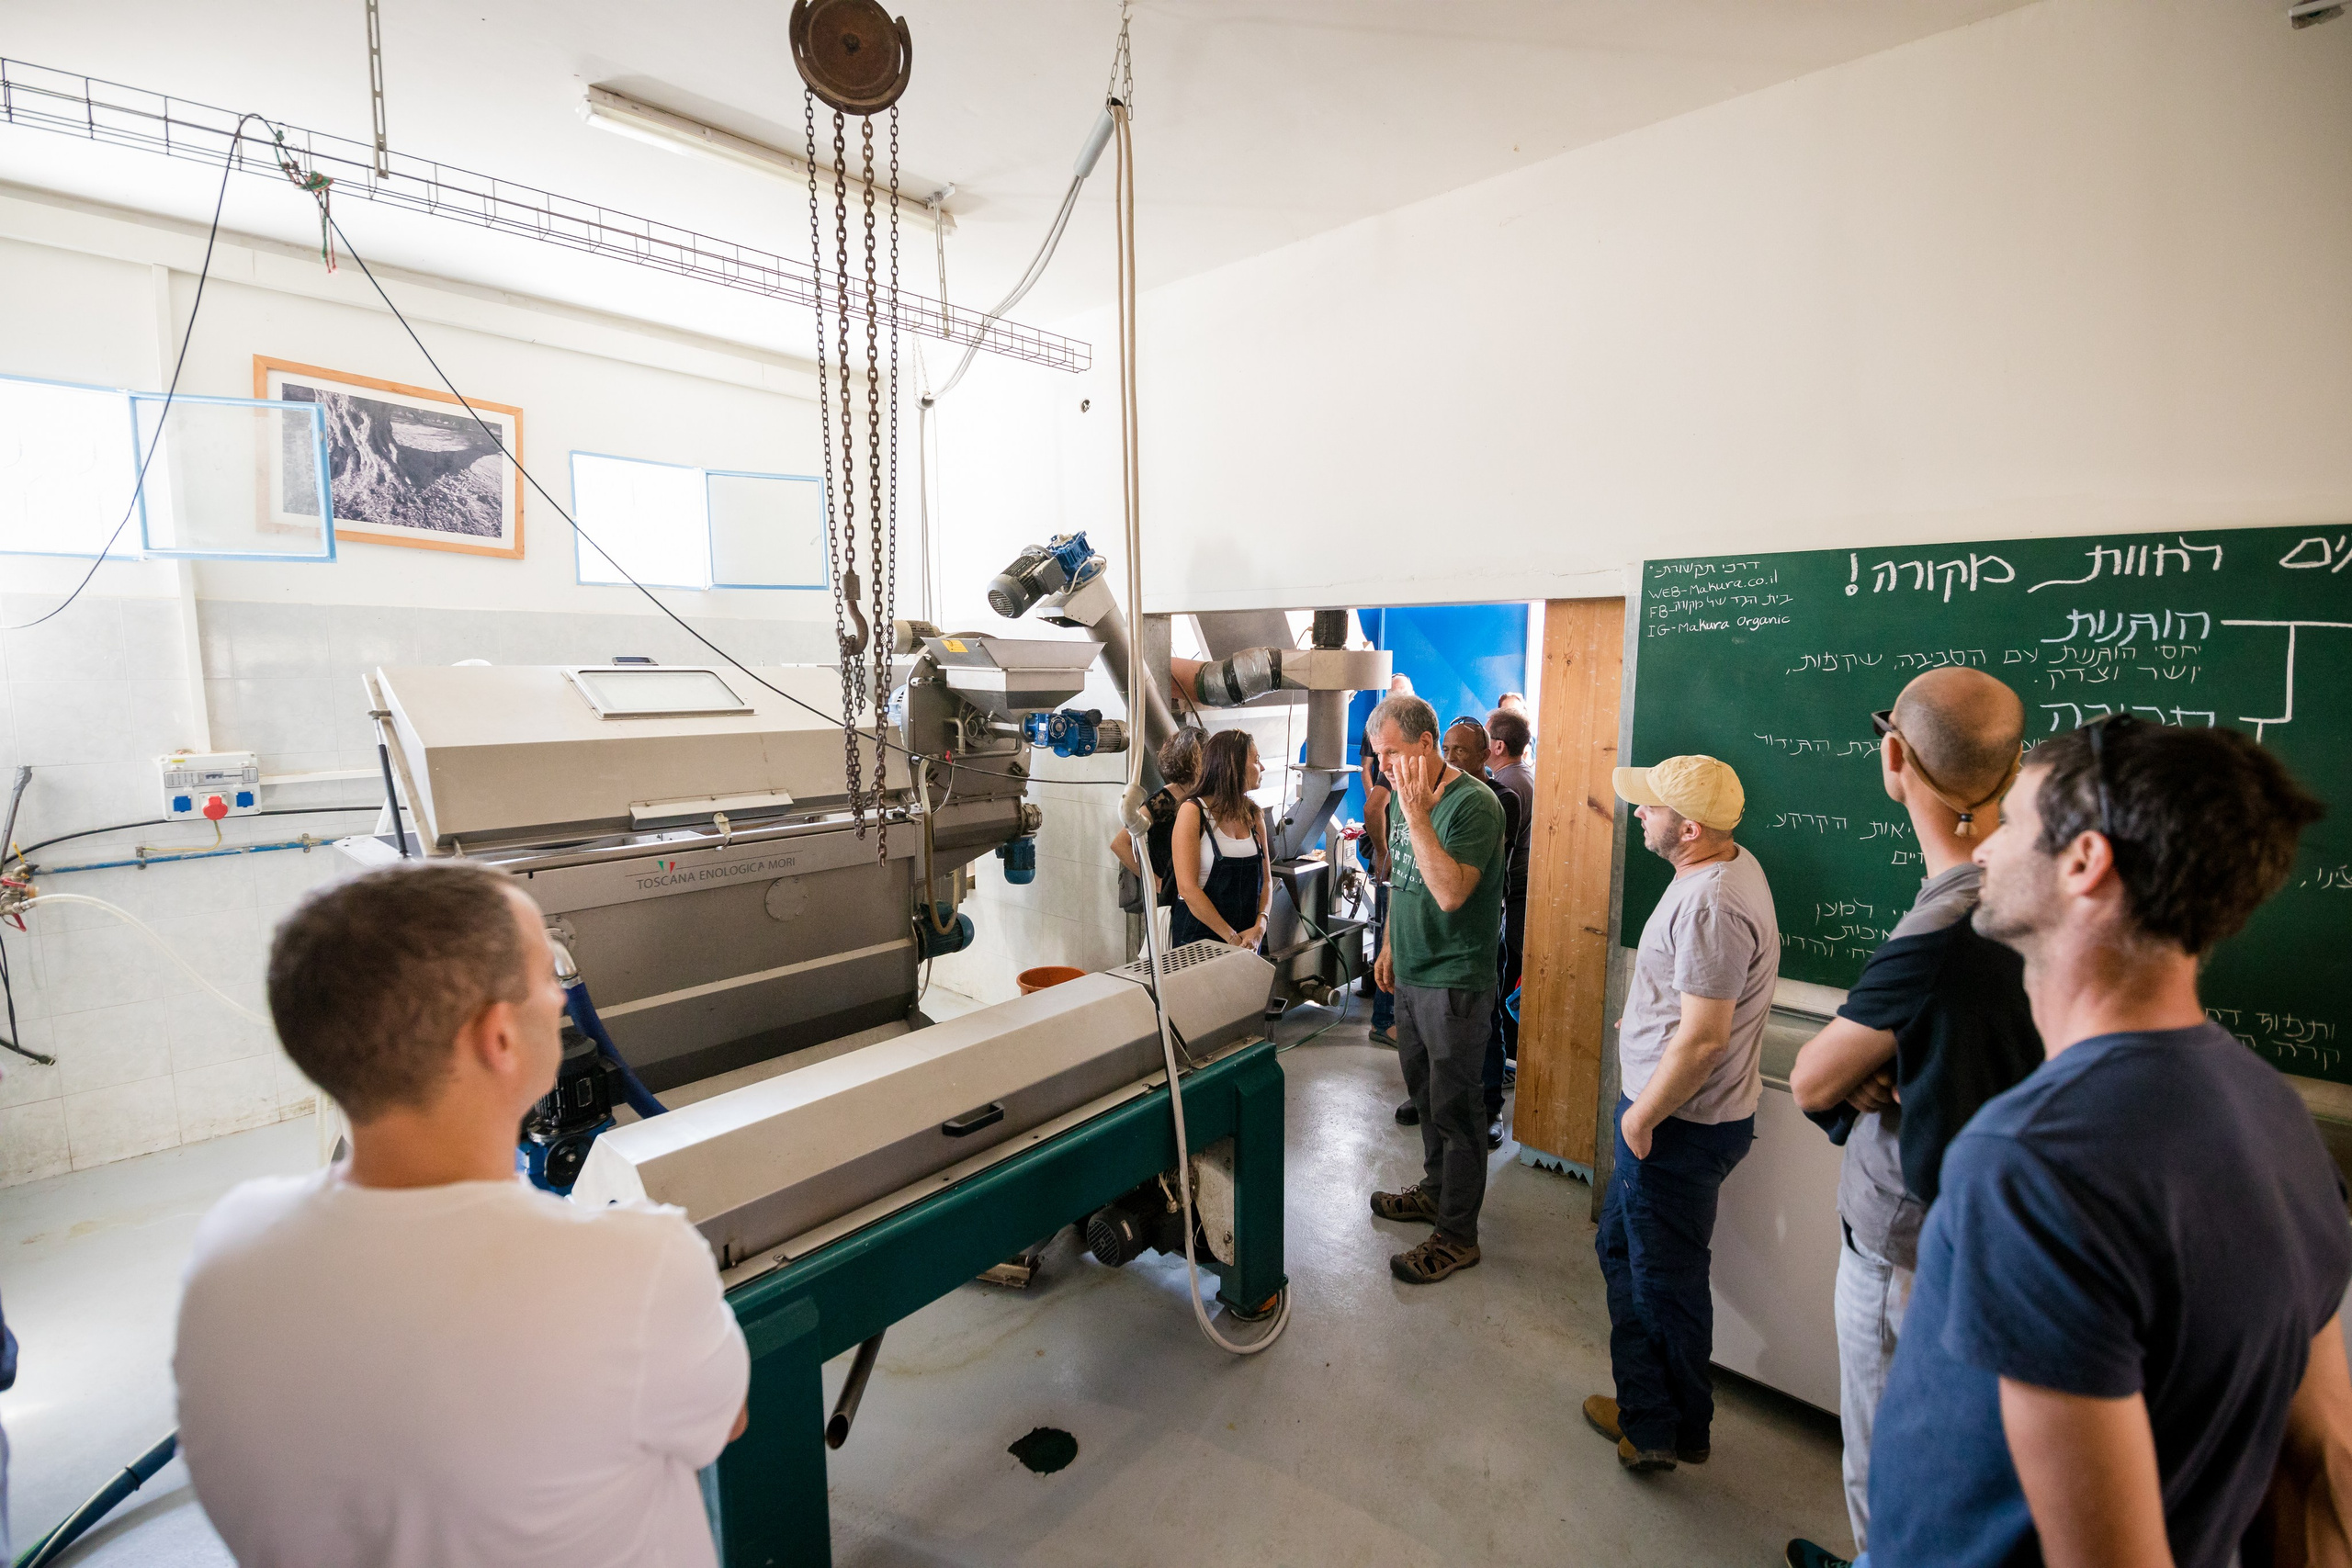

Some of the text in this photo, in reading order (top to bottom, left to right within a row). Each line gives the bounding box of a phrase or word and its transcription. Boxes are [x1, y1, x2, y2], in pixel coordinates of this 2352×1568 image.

[1736, 615, 1792, 631] Organic
[636, 857, 796, 890] TOSCANA ENOLOGICA MORI
